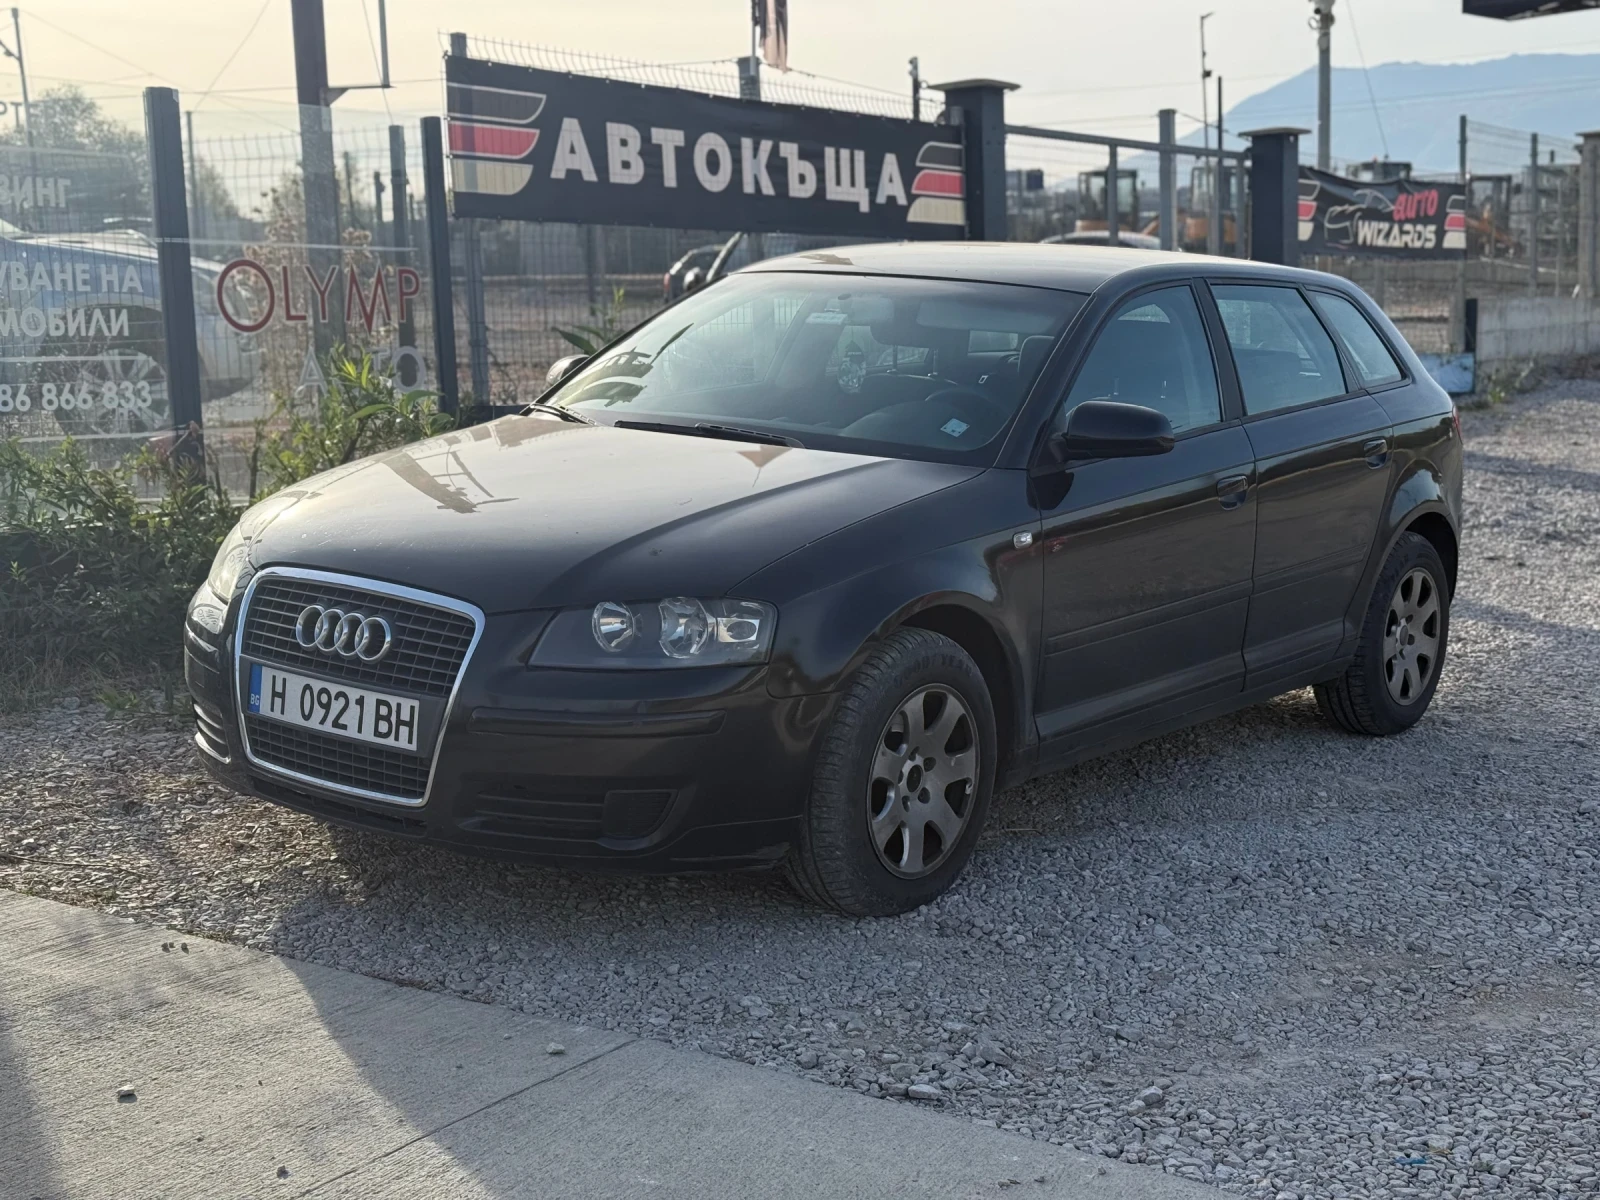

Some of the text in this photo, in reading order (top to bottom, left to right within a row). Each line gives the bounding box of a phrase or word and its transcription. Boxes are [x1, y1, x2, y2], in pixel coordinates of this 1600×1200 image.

[550, 117, 908, 213] АВТОКЪЩА
[1357, 219, 1437, 249] WIZARDS
[101, 264, 144, 293] НА
[216, 258, 421, 335] OLYMP
[42, 382, 93, 411] 866
[102, 380, 152, 409] 833
[250, 693, 260, 706] BG
[270, 674, 287, 715] H
